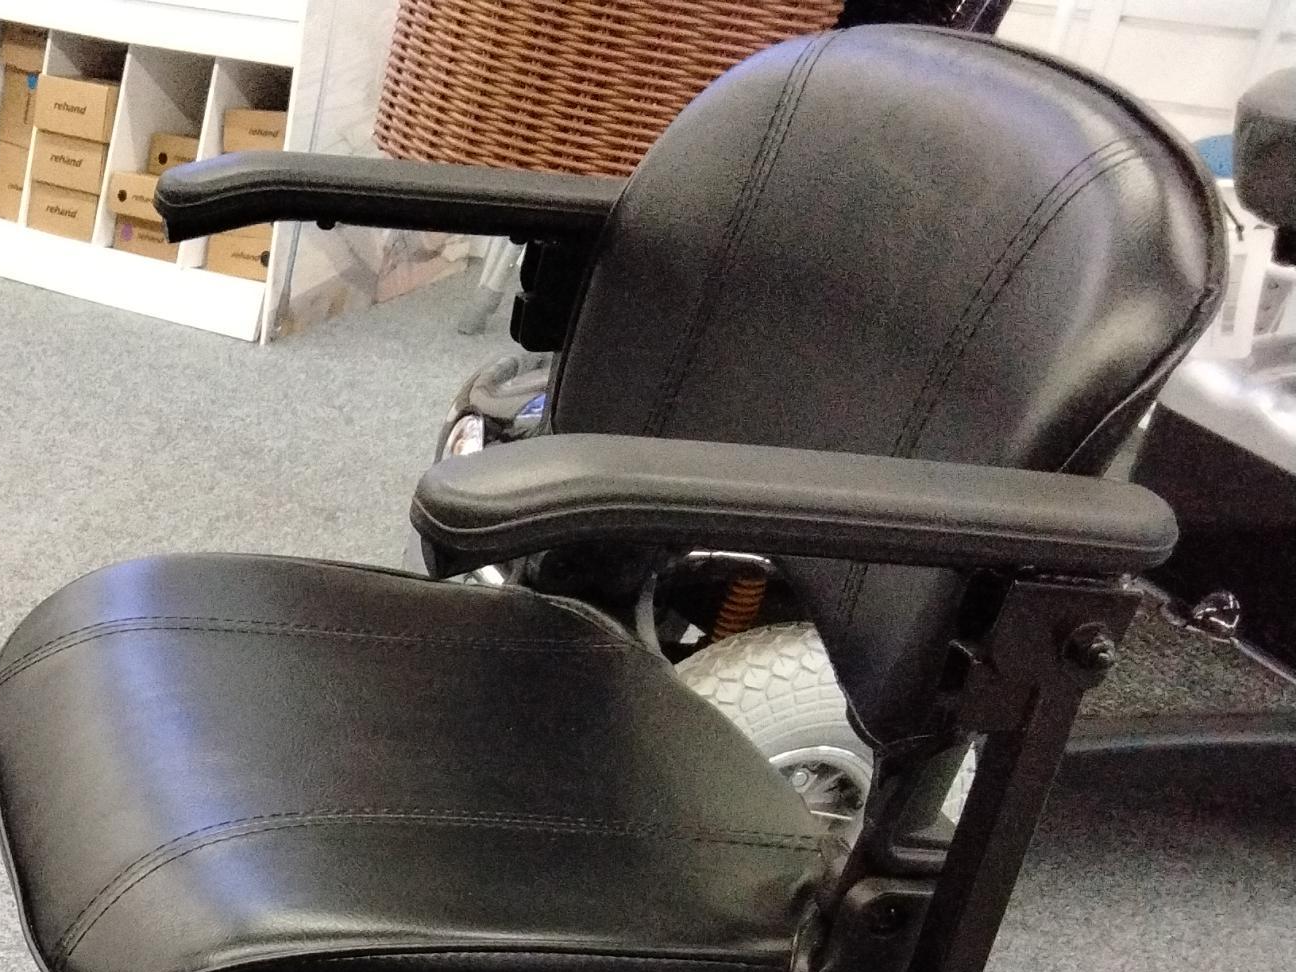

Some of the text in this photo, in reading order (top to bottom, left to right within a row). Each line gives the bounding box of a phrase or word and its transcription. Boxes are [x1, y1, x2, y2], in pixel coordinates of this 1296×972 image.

[53, 101, 87, 115] rehand
[49, 153, 83, 168] rehand
[46, 204, 78, 218] rehand
